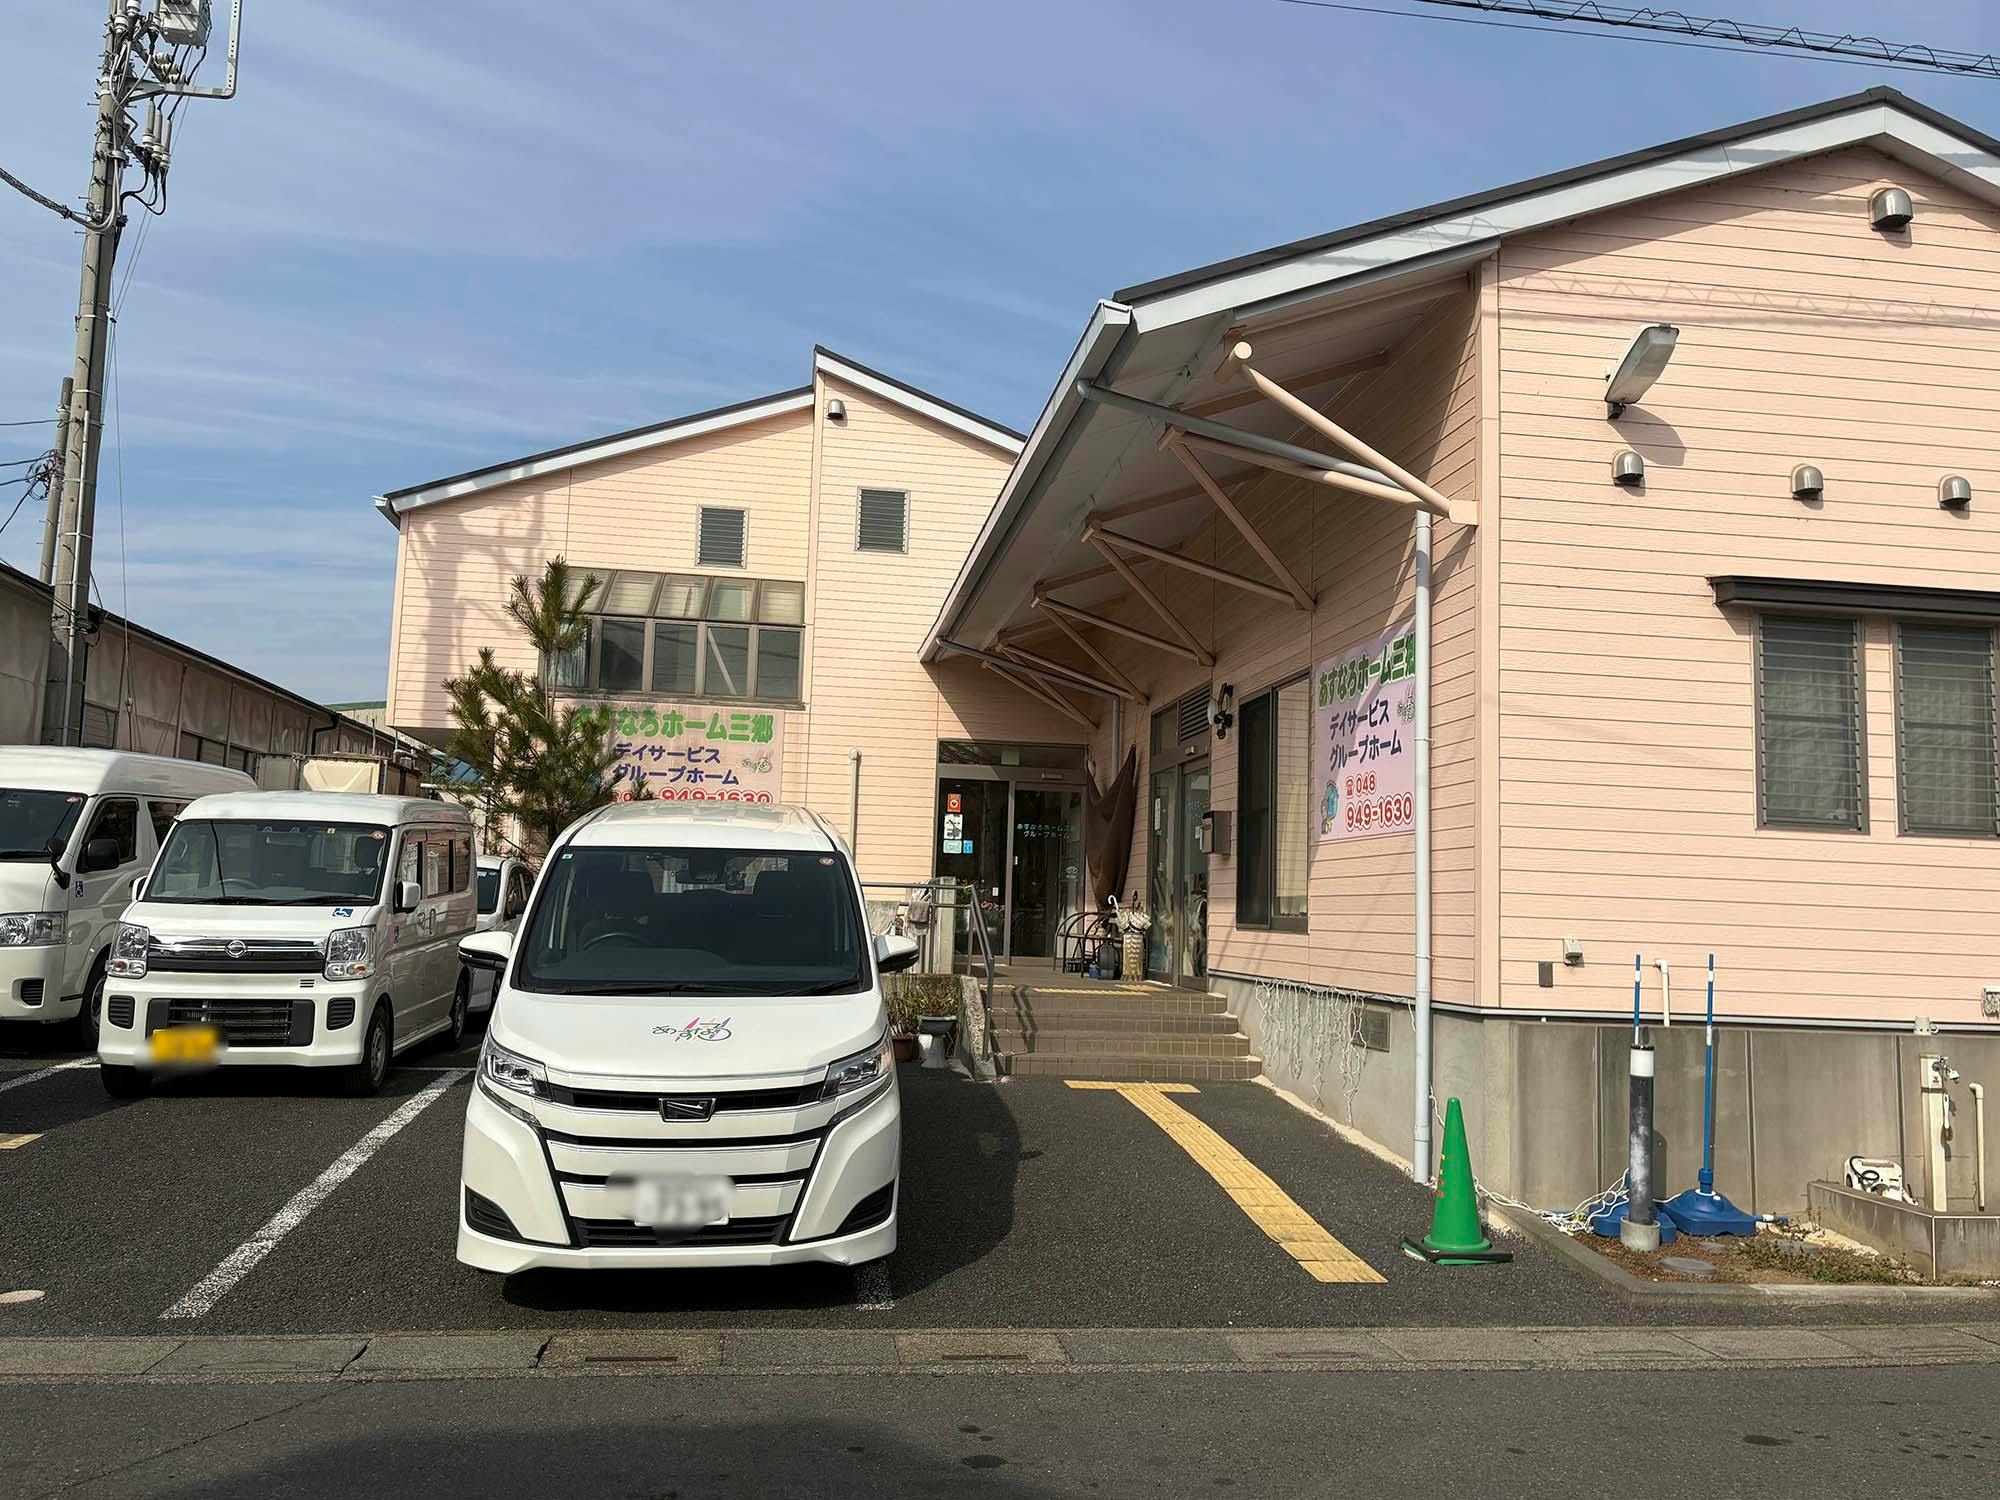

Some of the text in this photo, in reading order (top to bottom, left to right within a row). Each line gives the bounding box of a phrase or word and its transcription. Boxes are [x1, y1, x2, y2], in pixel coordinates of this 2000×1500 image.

[1330, 699, 1389, 740] デイサービス
[613, 743, 720, 764] デイサービス
[1330, 731, 1402, 770] グループホーム
[1356, 773, 1375, 795] 048
[1346, 795, 1413, 829] 949-1630
